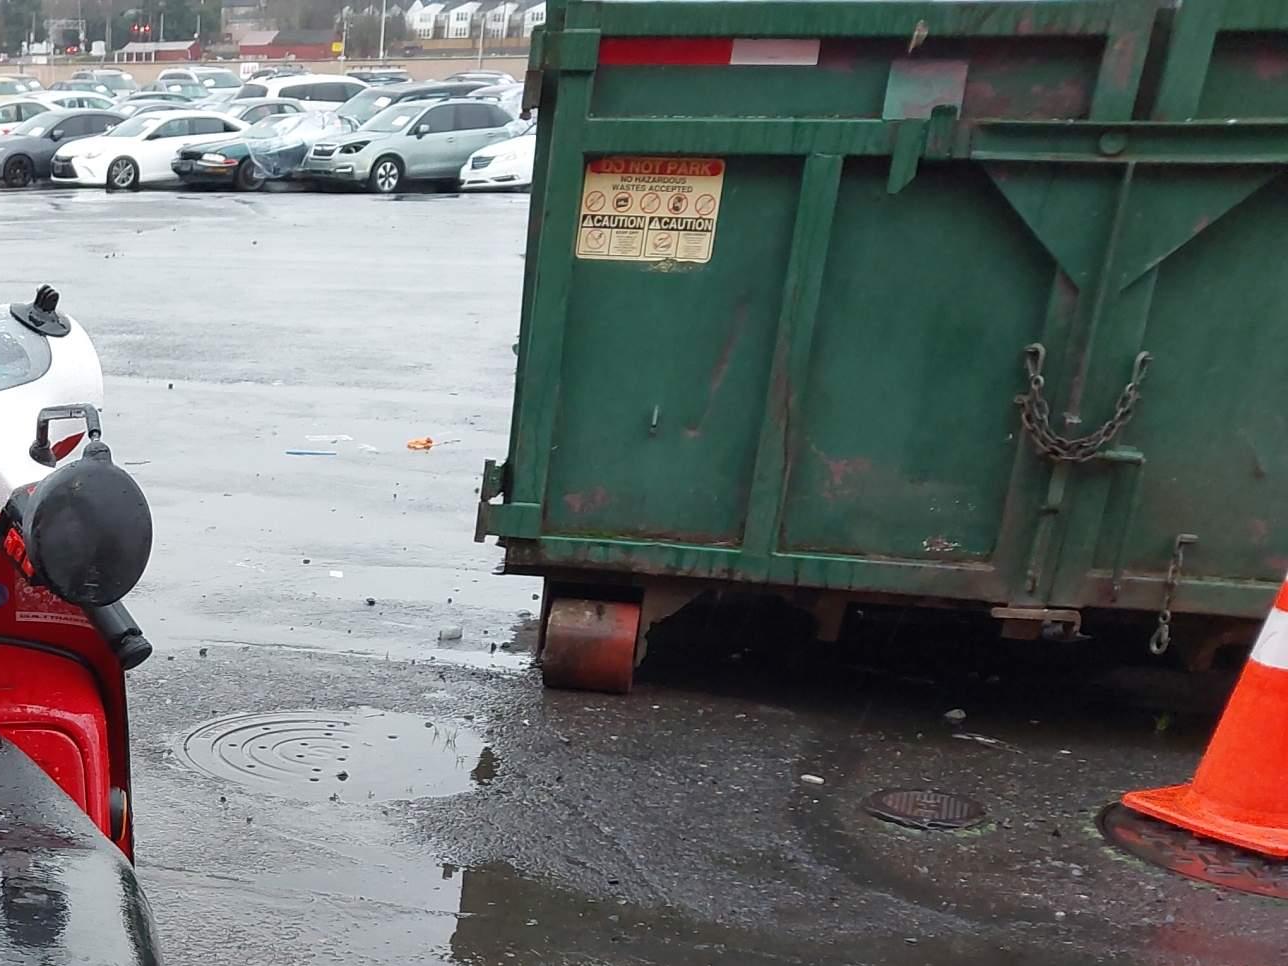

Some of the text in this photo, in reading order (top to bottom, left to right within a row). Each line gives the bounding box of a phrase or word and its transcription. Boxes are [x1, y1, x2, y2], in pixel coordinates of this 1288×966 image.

[601, 160, 712, 175] DO NOT PARK
[635, 176, 688, 184] HAZARDOUS
[612, 184, 693, 193] WASTES ACCEPTED
[593, 215, 645, 229] CAUTION
[661, 217, 713, 231] CAUTION
